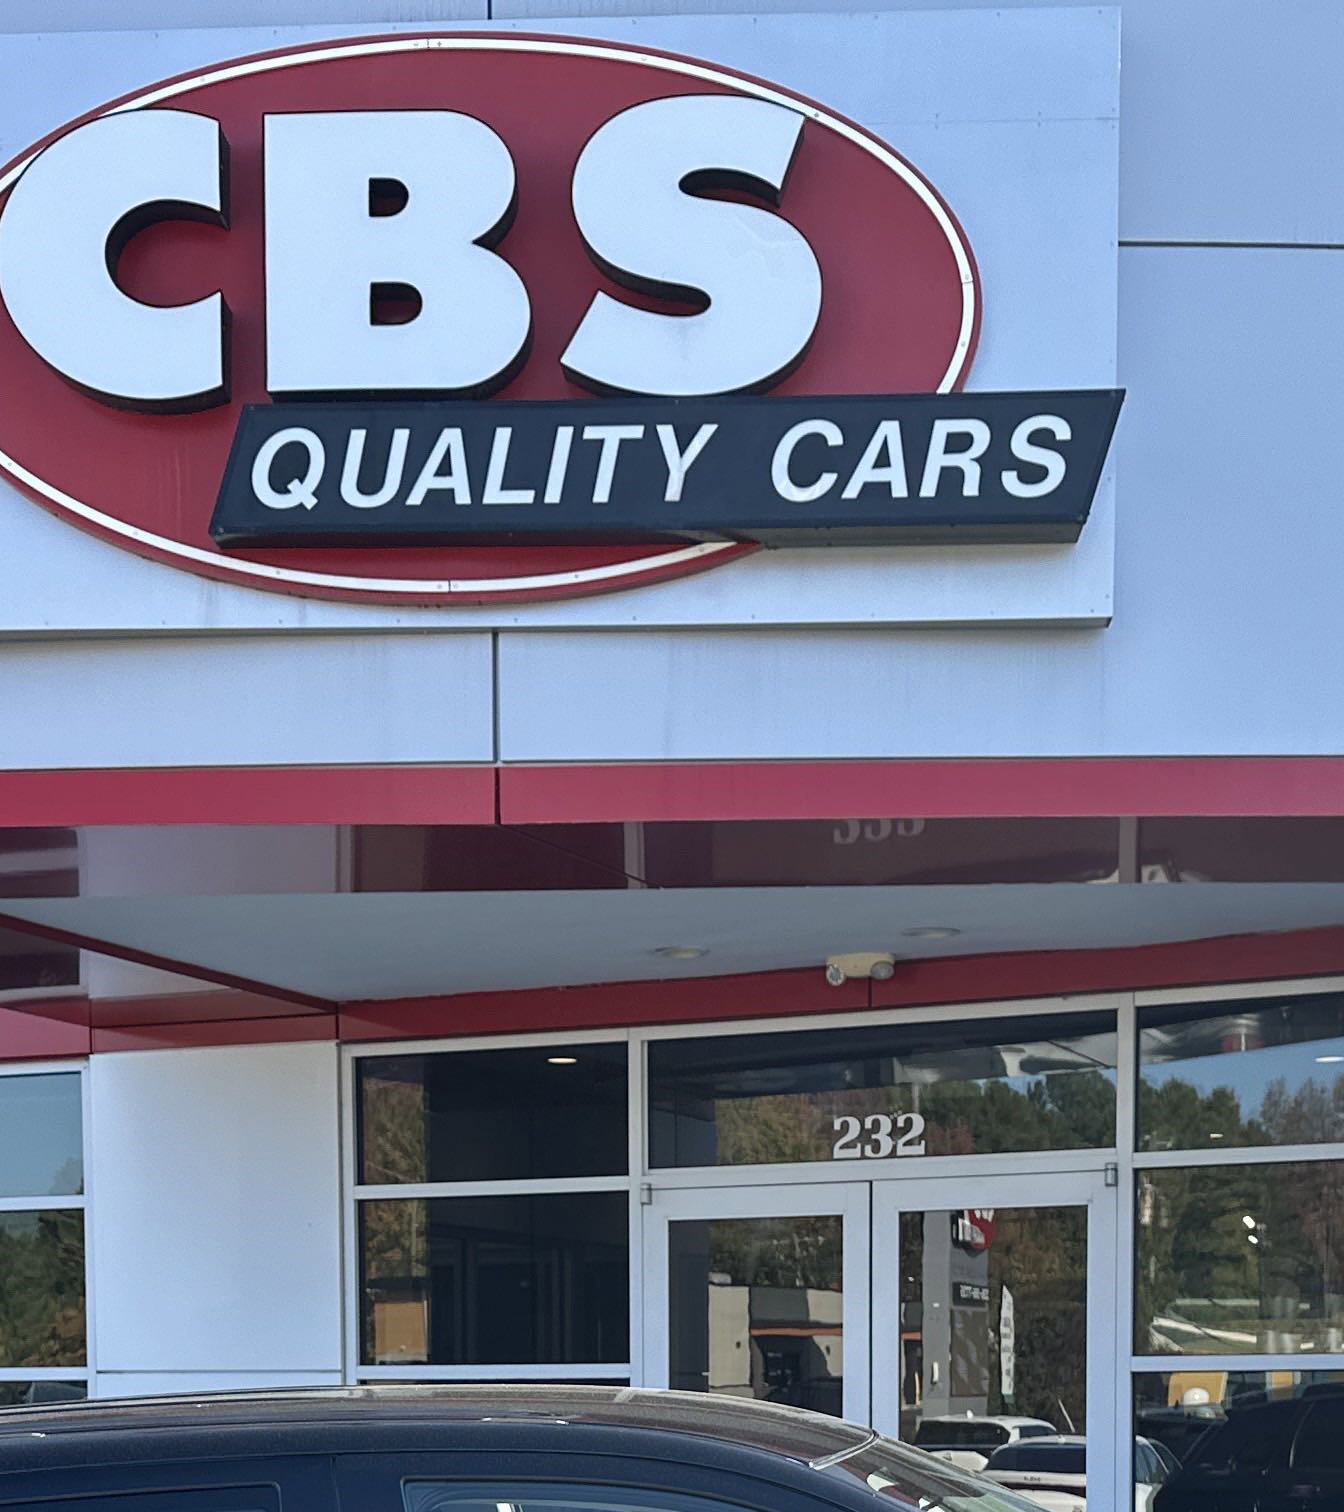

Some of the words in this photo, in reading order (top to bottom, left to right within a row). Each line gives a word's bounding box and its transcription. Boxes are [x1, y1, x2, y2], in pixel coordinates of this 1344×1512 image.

[249, 422, 719, 512] QUALITY
[770, 413, 1073, 503] CARS
[832, 1114, 926, 1160] 232
